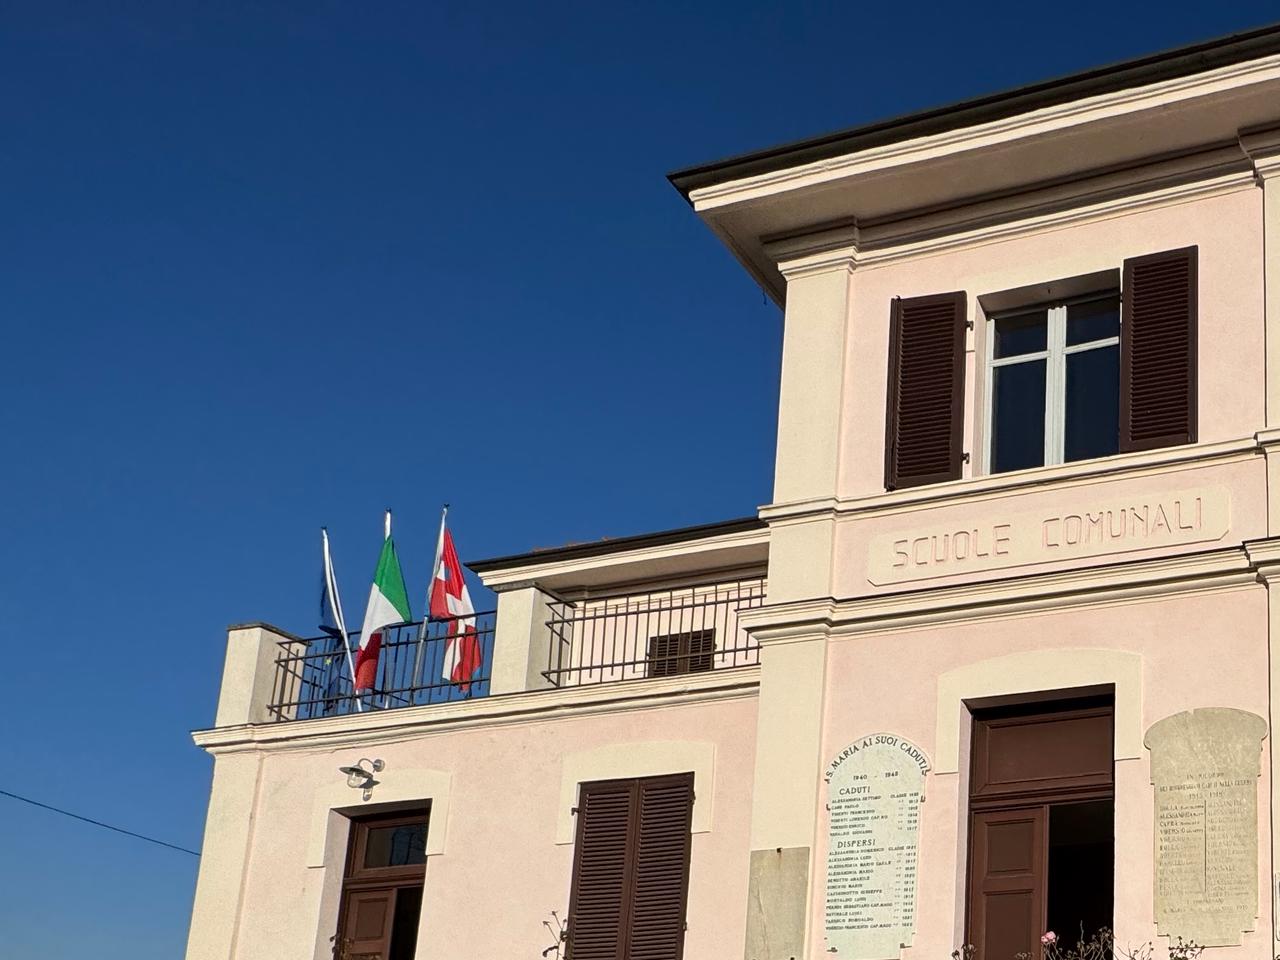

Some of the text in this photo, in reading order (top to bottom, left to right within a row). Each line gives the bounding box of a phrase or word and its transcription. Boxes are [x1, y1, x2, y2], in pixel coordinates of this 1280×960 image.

[892, 497, 1202, 567] SCUOLE COMUNALI
[831, 745, 859, 770] MARIA
[862, 738, 873, 748] AI
[875, 735, 898, 747] SUOI
[900, 742, 928, 770] CADUTI
[839, 786, 871, 795] CADUTI
[837, 839, 876, 848] DISPERSI
